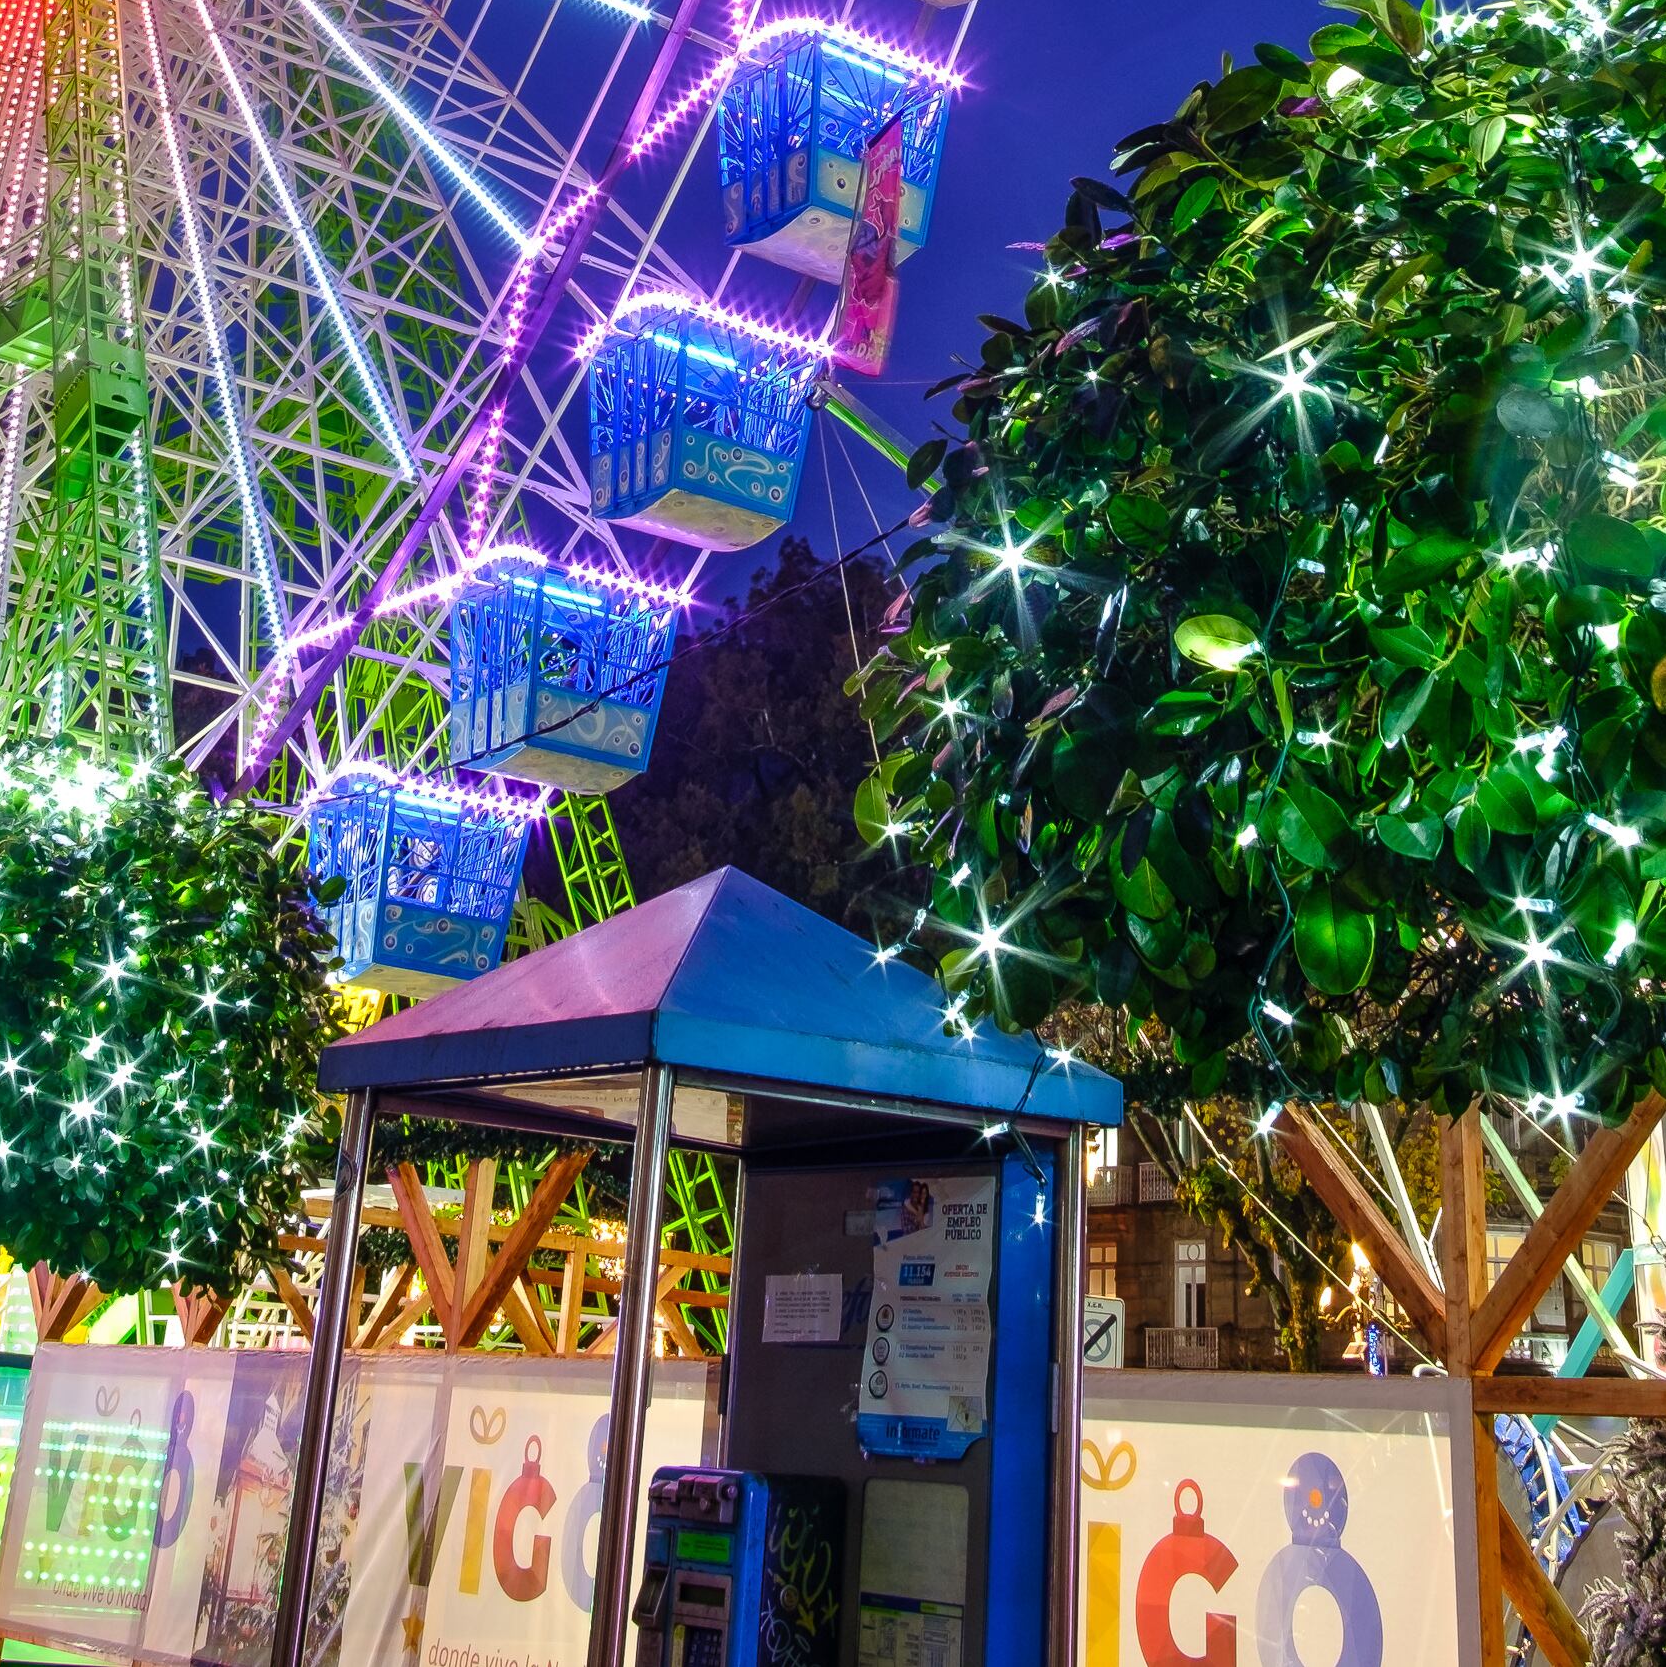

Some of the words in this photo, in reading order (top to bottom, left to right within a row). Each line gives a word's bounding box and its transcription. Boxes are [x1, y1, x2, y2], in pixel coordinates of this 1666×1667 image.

[941, 1203, 974, 1215] OFERTA
[976, 1203, 988, 1214] DE
[947, 1216, 982, 1228] EMPLEO
